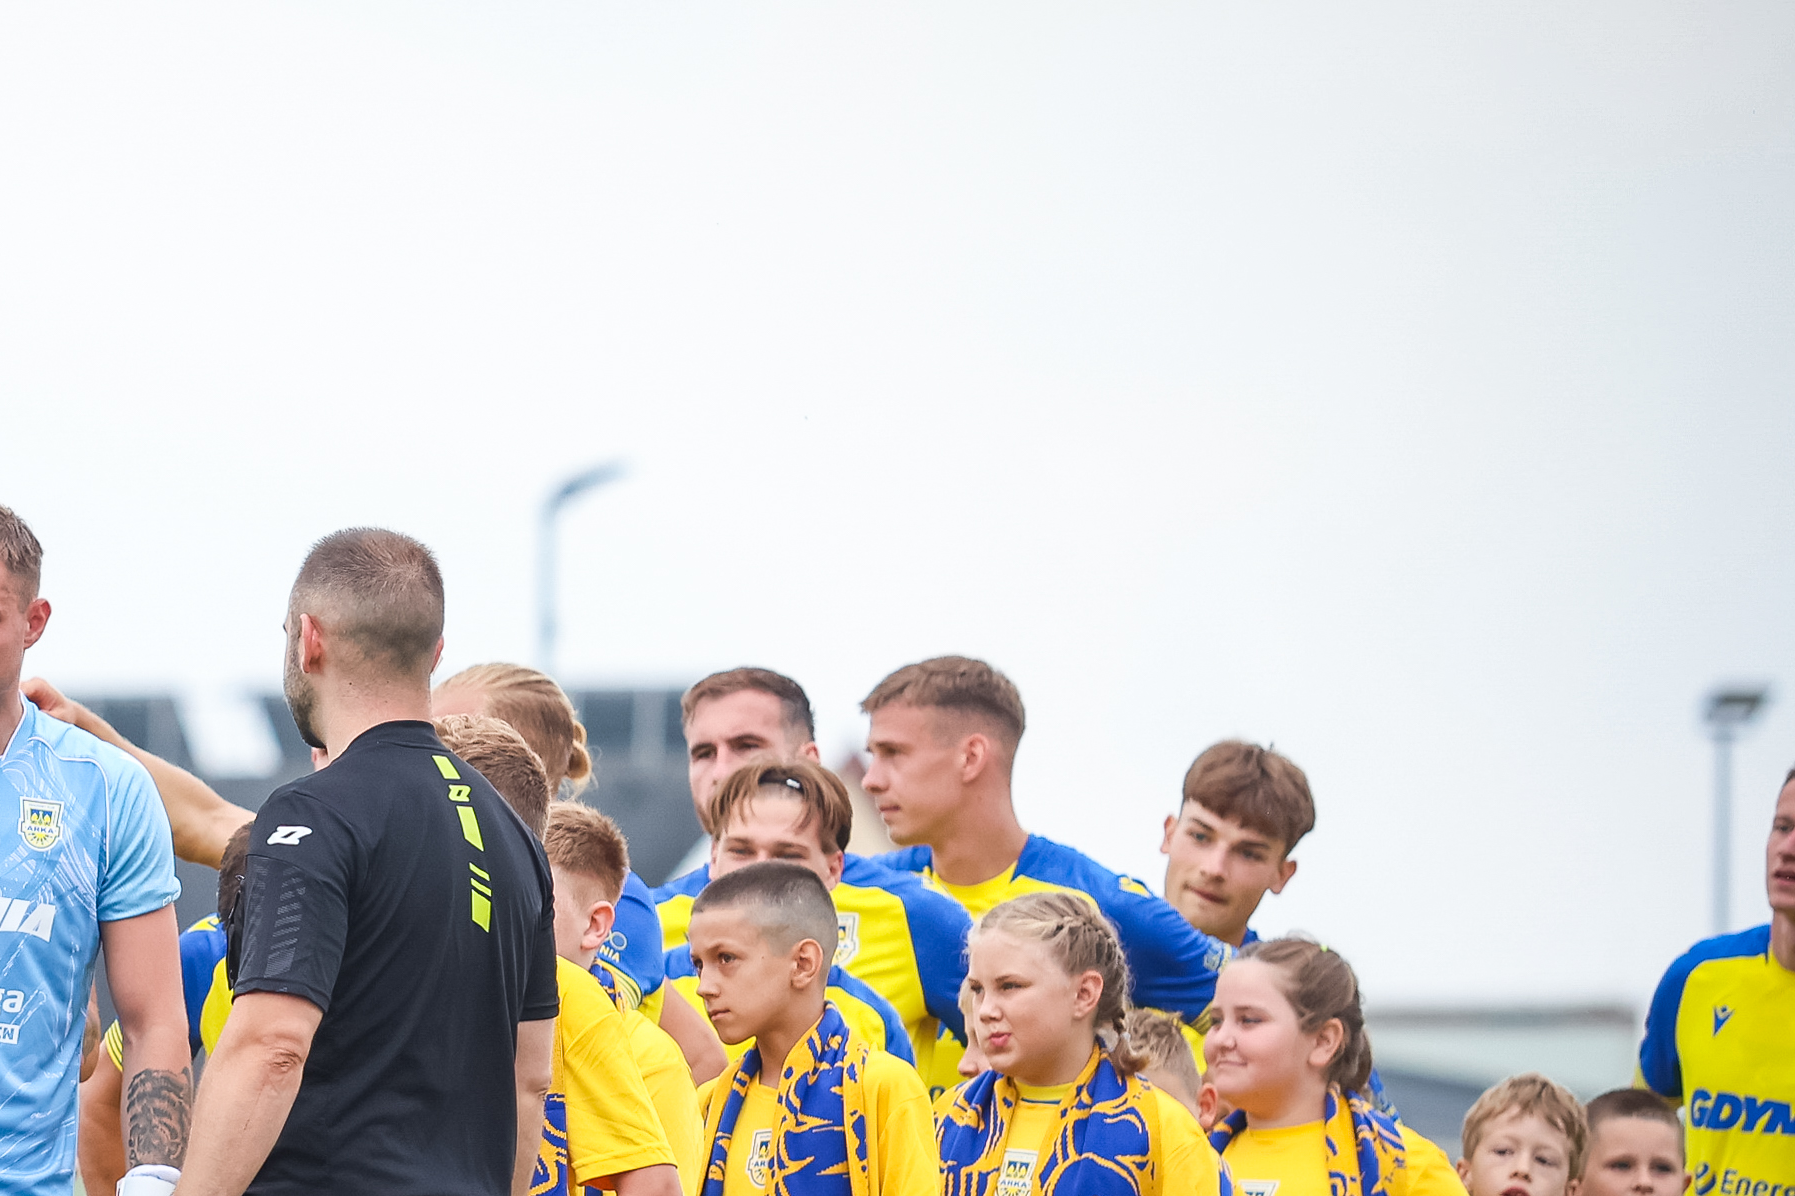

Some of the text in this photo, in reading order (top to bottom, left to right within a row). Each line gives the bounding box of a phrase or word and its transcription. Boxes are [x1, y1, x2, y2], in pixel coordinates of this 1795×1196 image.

[27, 825, 54, 834] ARKA
[599, 944, 620, 964] NIA
[1691, 1088, 1795, 1135] GDYN
